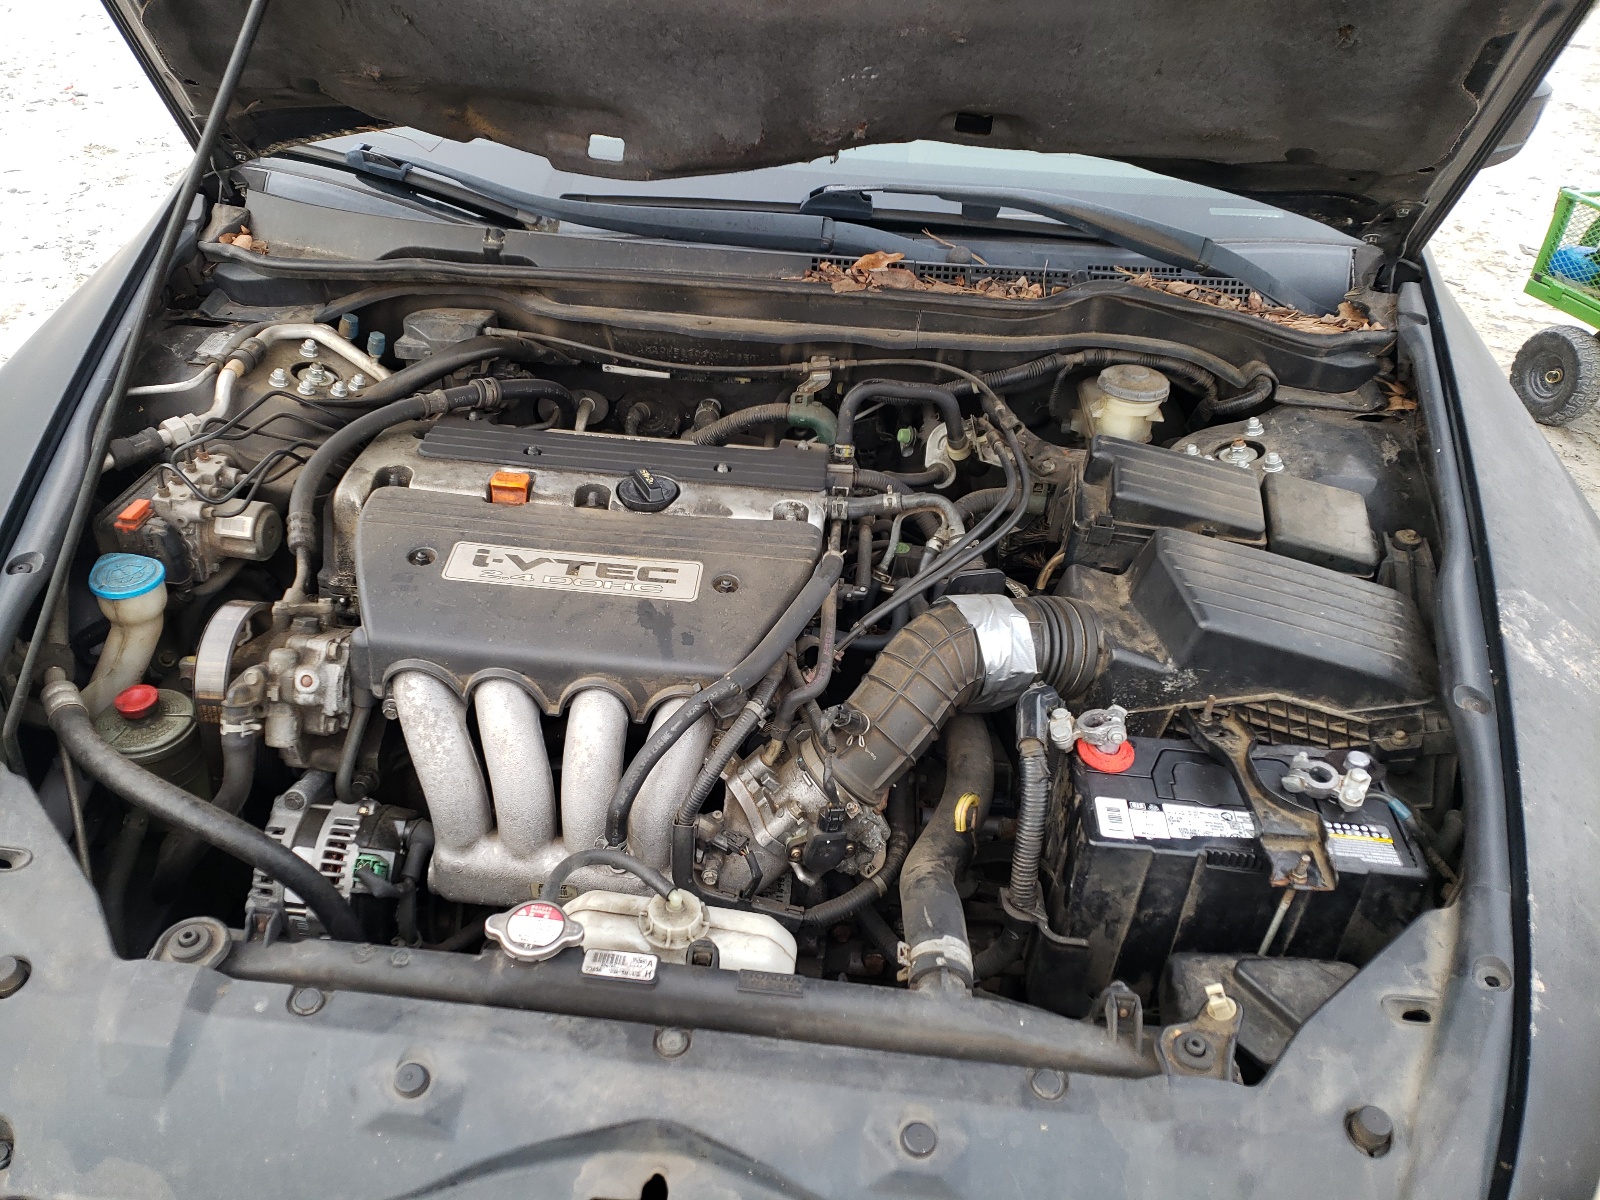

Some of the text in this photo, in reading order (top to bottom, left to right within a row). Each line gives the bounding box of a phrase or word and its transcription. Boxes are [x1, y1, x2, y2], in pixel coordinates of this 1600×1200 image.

[472, 548, 680, 585] i-VTEC
[480, 569, 664, 594] 2.4 DOHC
